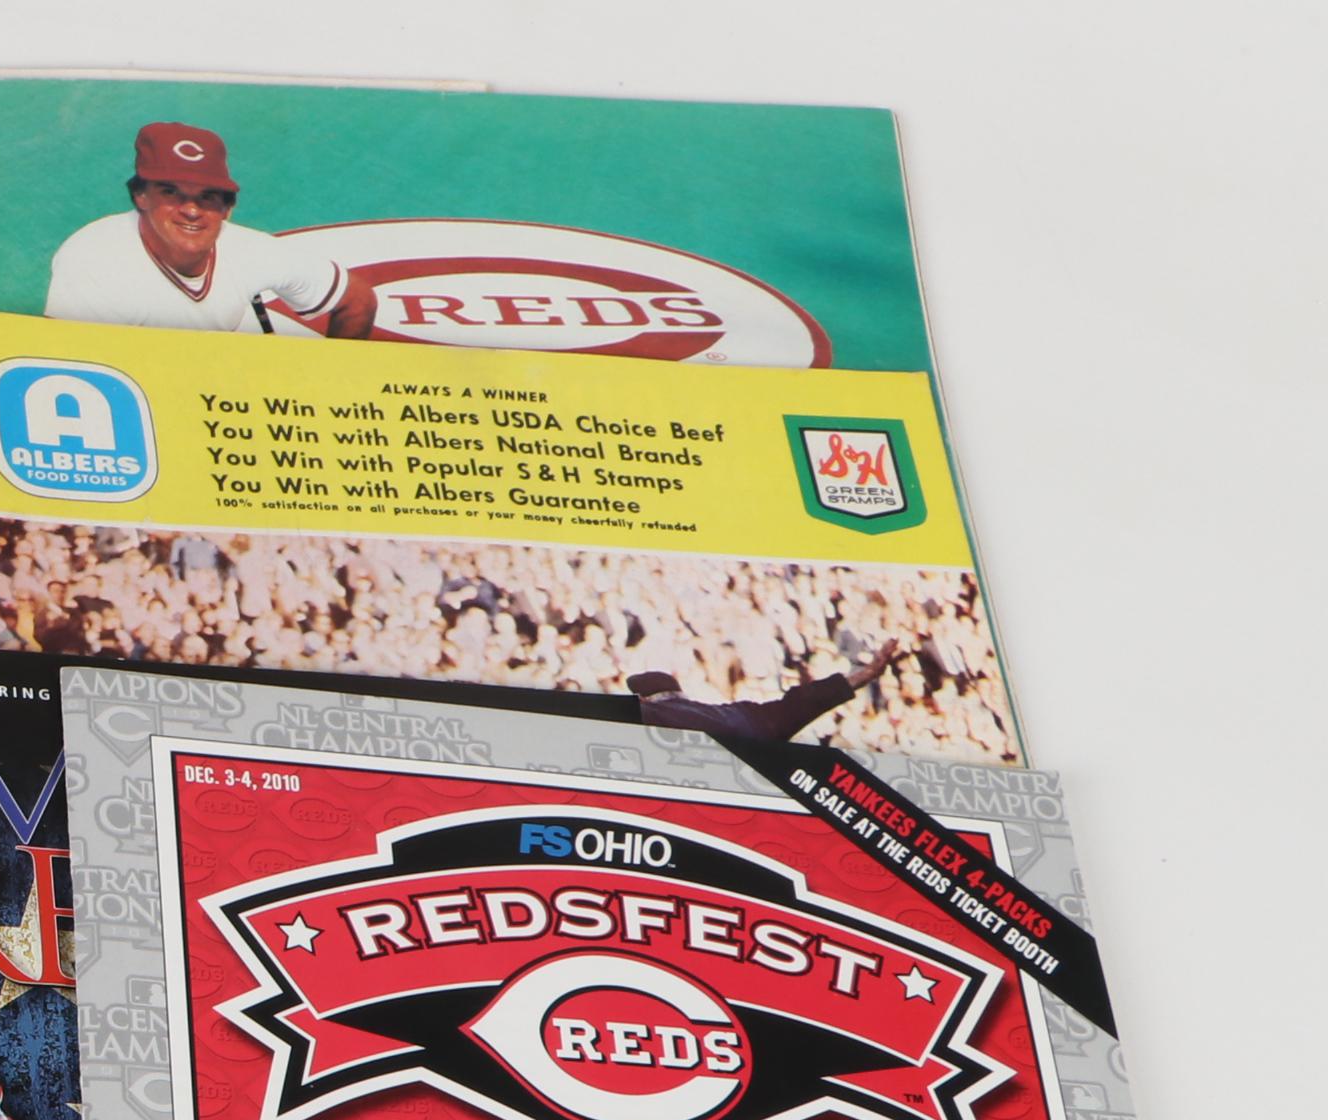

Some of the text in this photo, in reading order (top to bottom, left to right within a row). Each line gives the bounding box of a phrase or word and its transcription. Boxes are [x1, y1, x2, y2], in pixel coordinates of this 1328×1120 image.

[387, 289, 725, 328] REDS
[381, 383, 548, 403] ALWAYS A WINNER
[200, 394, 725, 442] You Win with Albers USDA Choice Beef
[11, 446, 141, 475] ALBERS
[203, 420, 703, 466] You Win with Albers National Brands
[27, 469, 127, 487] FOOD STORES
[207, 446, 684, 493] You Win with Popular S & H Stamps
[210, 474, 641, 513] You Win with Albers Guarantee
[824, 484, 895, 498] GREEN
[827, 495, 898, 507] STAMPS
[215, 497, 697, 533] 100% satisfaction on all purchases or your money cheerfully refunded
[184, 765, 301, 792] DEC. 3-4, 2010
[825, 762, 1054, 942] YANKEES FLEX 4-PACKS
[789, 768, 1062, 979] ON SALE AT THE REDS TICKET BOOTH
[339, 885, 882, 1001] REDSFEST
[552, 1015, 743, 1074] REDS
